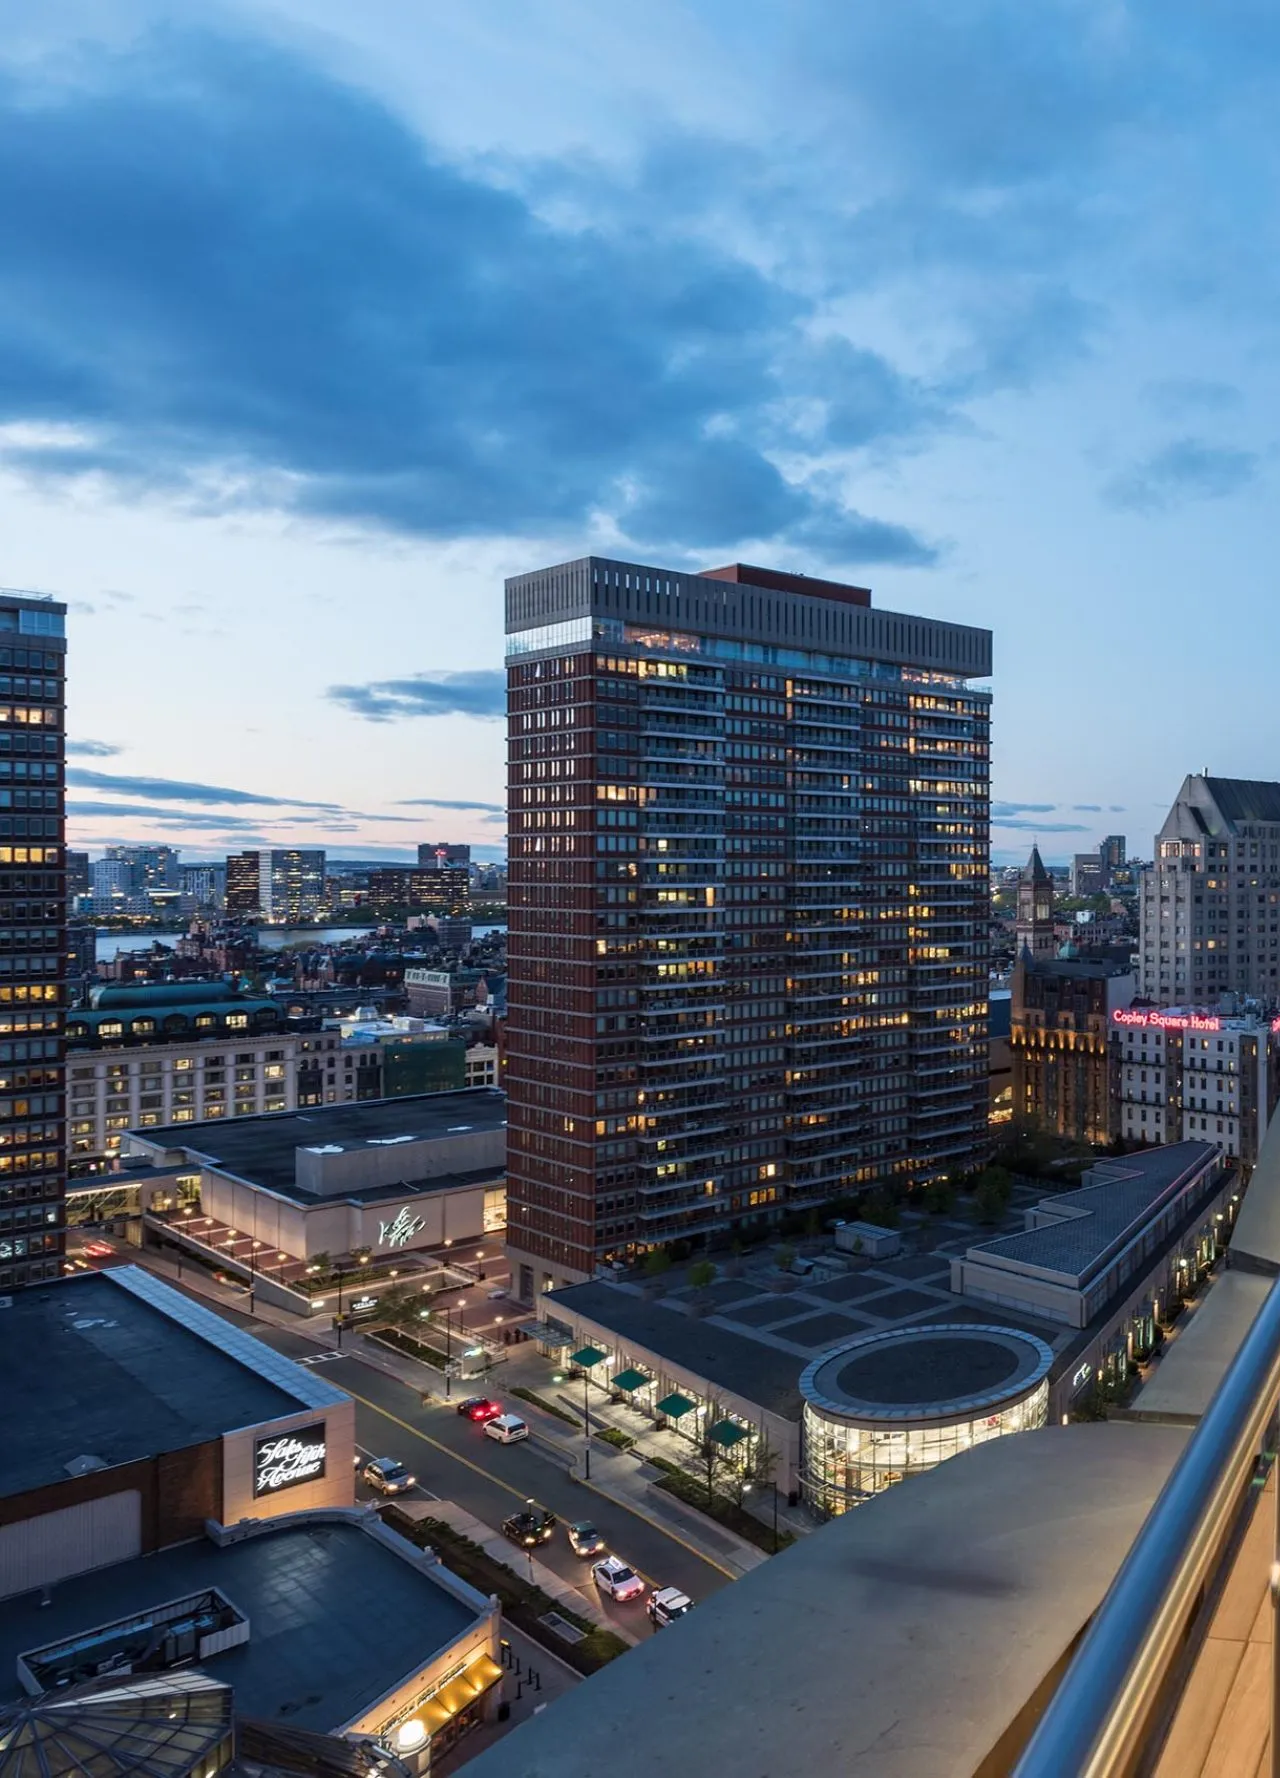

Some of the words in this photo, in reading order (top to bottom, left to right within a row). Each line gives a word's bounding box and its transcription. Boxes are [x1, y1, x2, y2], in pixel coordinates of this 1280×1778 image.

[1113, 1009, 1147, 1026] Copley
[1149, 1012, 1189, 1028] Square
[1191, 1015, 1219, 1030] Hotel
[257, 1438, 302, 1468] Saks
[279, 1443, 326, 1471] Fifth
[257, 1461, 321, 1491] Avenue
